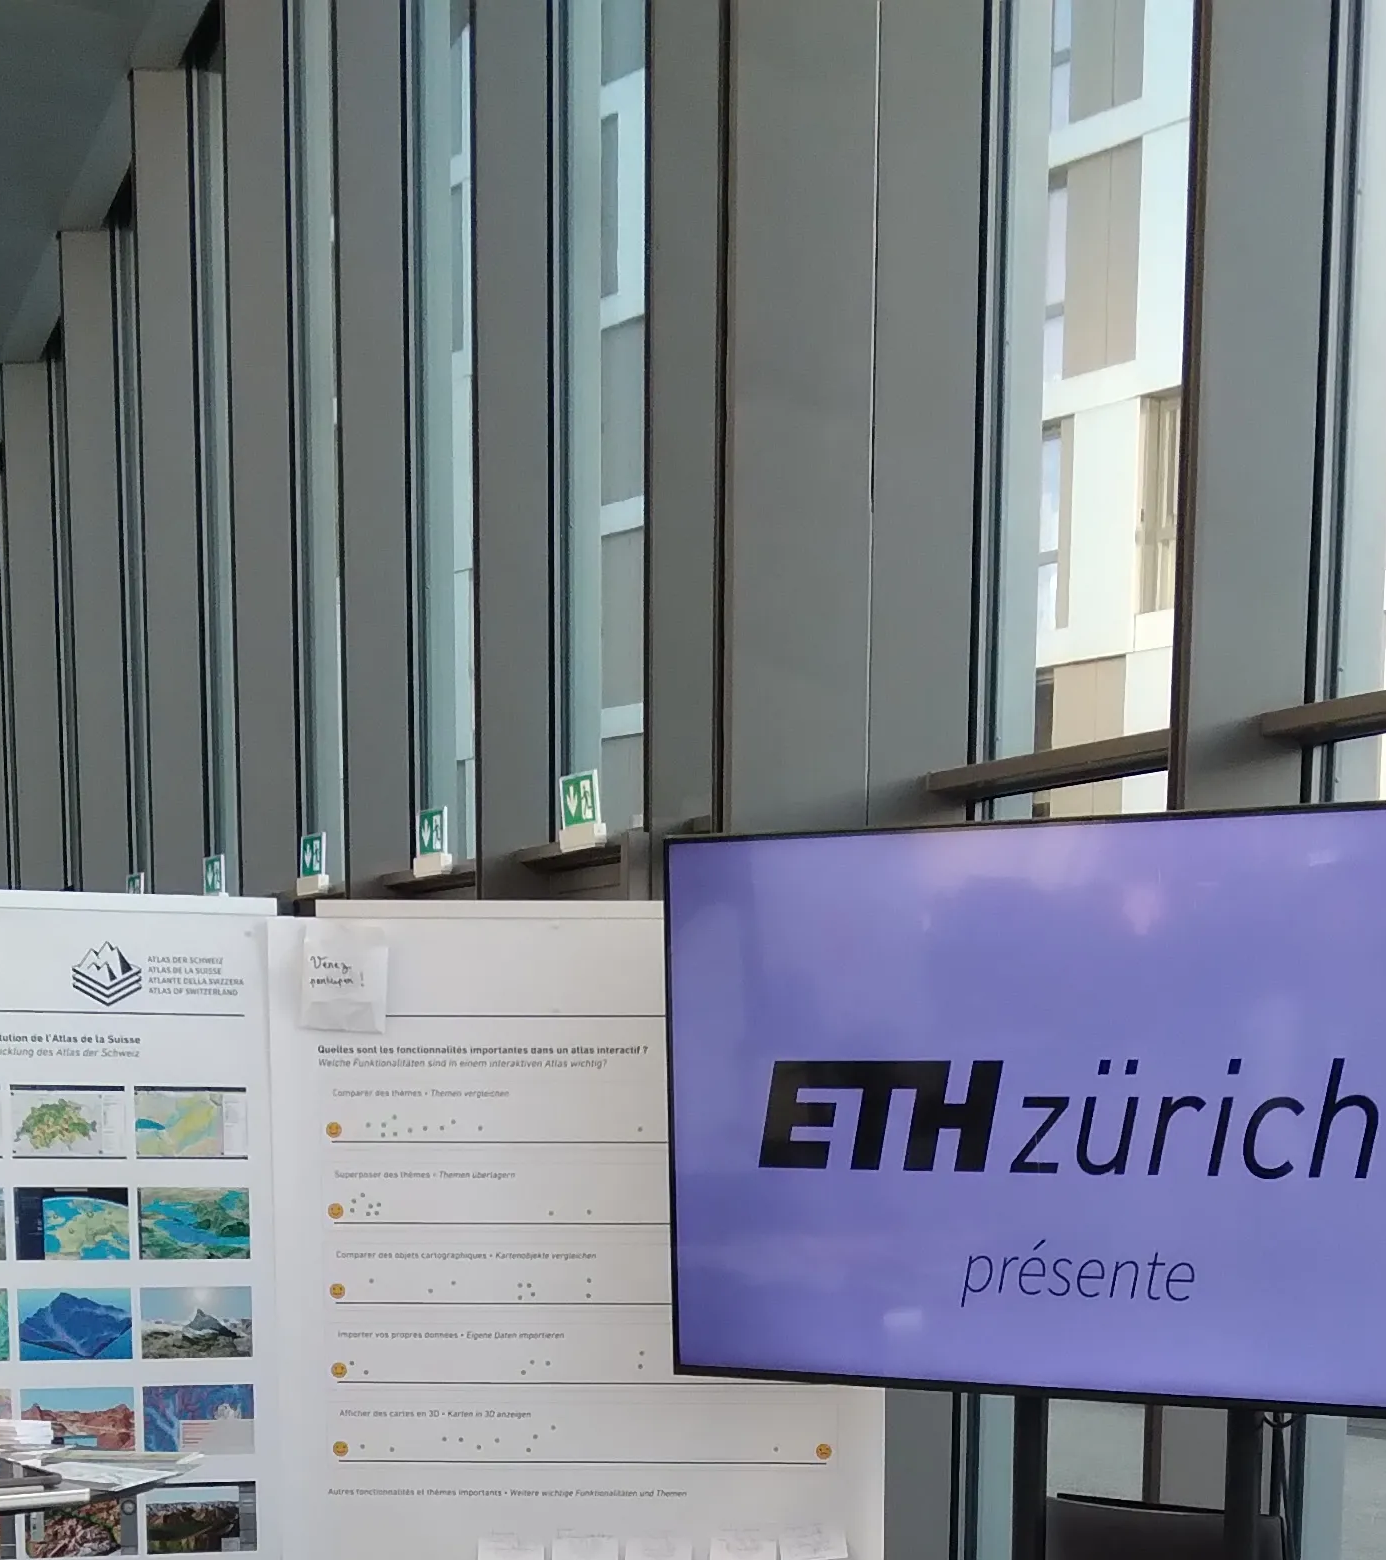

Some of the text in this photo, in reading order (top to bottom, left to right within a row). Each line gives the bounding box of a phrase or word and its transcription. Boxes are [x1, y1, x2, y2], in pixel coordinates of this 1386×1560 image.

[147, 955, 224, 965] ATLAS DER SCHWEIZ
[148, 966, 172, 974] ATLAS
[195, 967, 221, 975] SUISSE
[183, 977, 207, 985] DELLA
[208, 978, 244, 986] SVIZZERA
[185, 988, 238, 996] SWITZERLAND
[29, 1034, 44, 1042] de
[44, 1033, 79, 1043] l'Atlas
[79, 1035, 93, 1043] de
[93, 1034, 106, 1043] la
[106, 1034, 141, 1044] Suisse
[34, 1047, 55, 1056] des
[54, 1047, 82, 1057] Atlas
[81, 1048, 100, 1057] der
[98, 1047, 141, 1058] Schweiz
[317, 1045, 354, 1054] Quelles
[355, 1045, 377, 1054] sont
[378, 1045, 394, 1054] les
[469, 1046, 529, 1056] importantes
[569, 1045, 596, 1054] atlas
[595, 1045, 641, 1054] interactif
[317, 1058, 352, 1067] Welche
[426, 1059, 447, 1067] sind
[487, 1059, 544, 1068] interaktiven
[542, 1059, 570, 1068] Atlas
[567, 1058, 609, 1069] wichtig?
[960, 1239, 1196, 1308] présente
